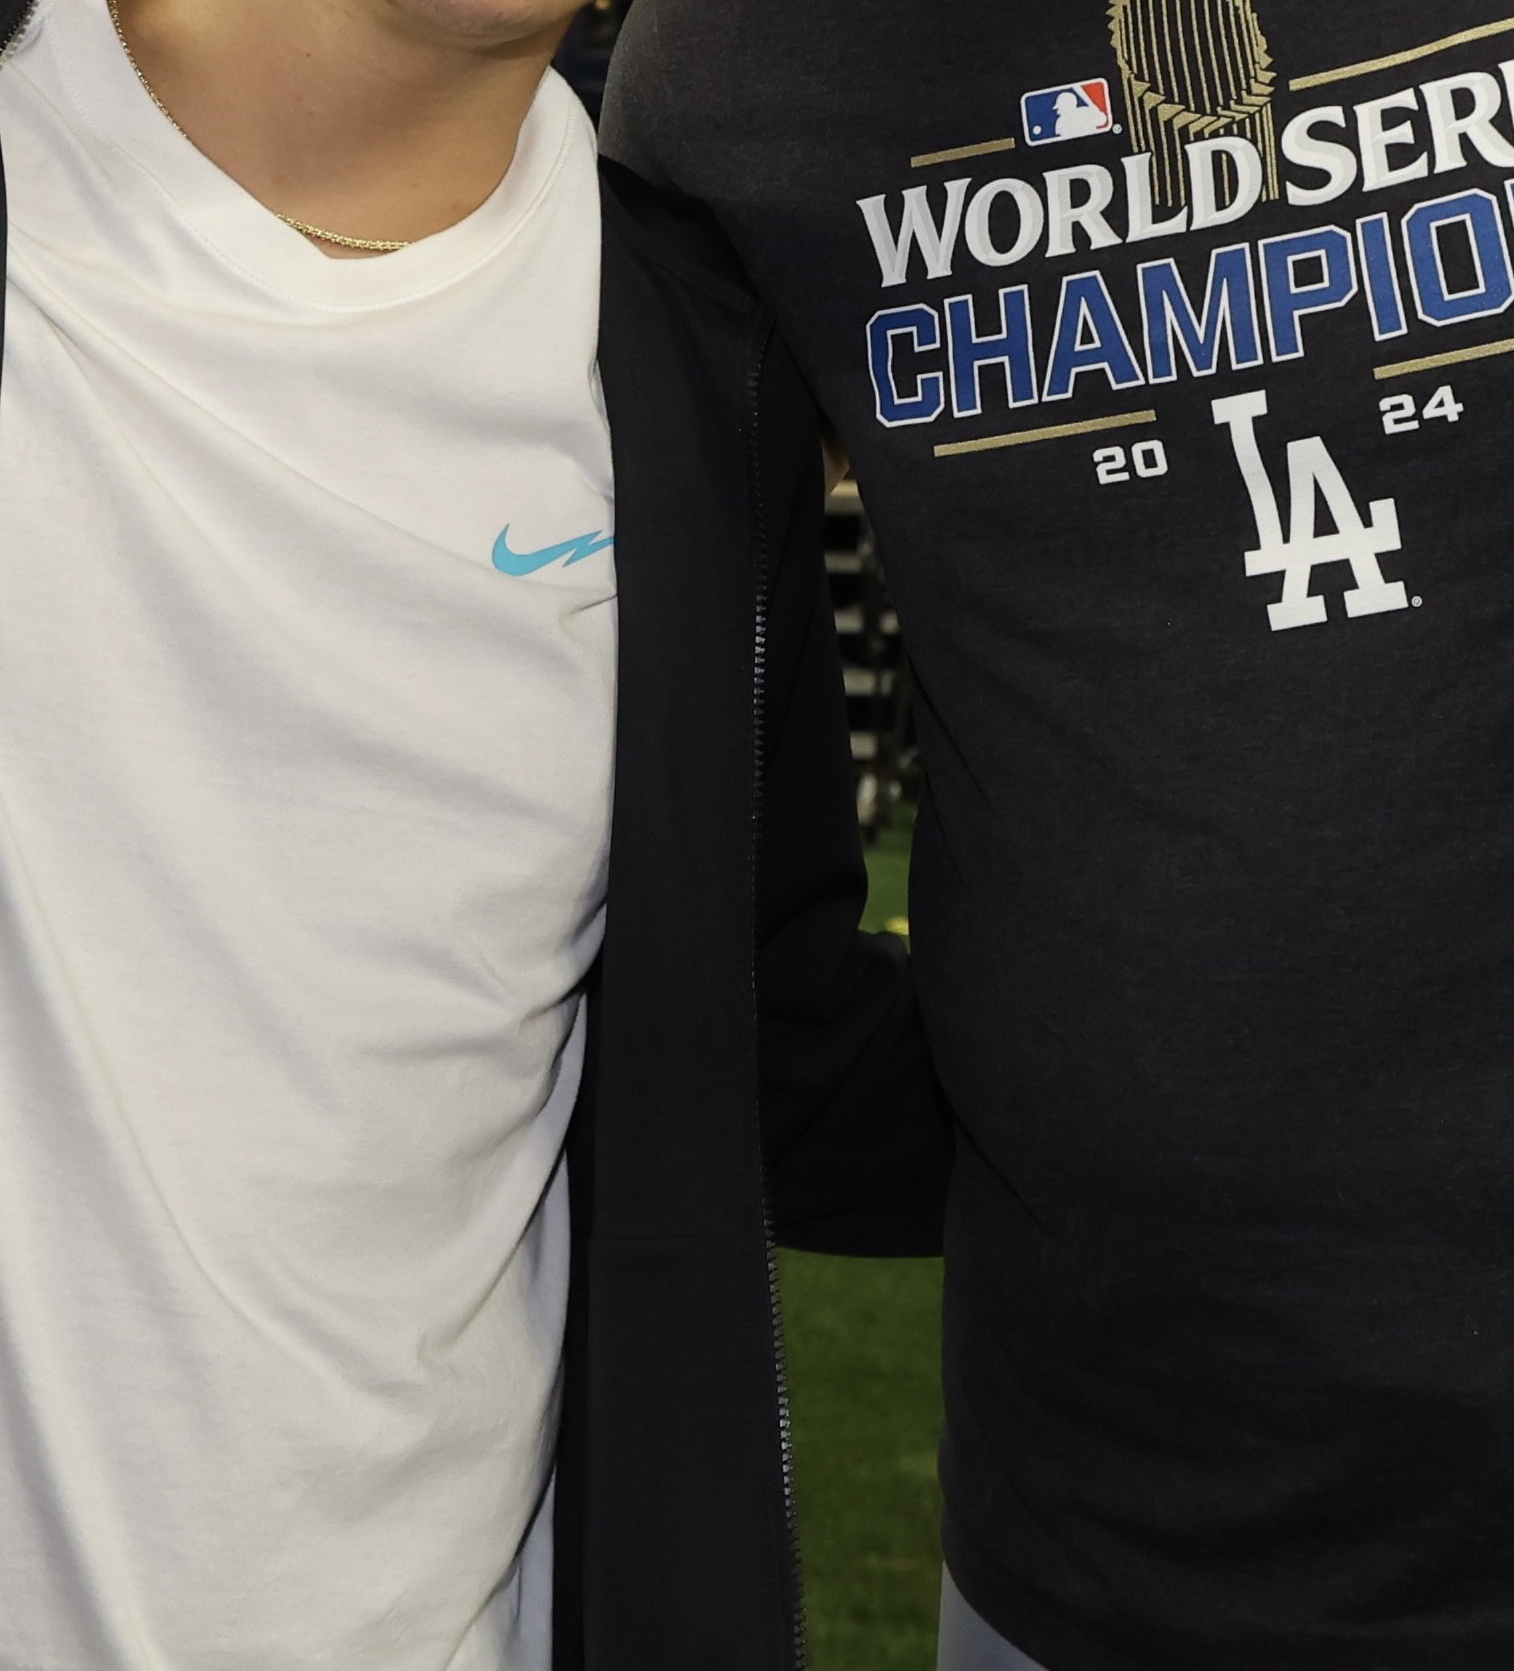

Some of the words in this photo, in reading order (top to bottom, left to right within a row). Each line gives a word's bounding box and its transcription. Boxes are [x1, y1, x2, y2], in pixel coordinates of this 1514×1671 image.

[855, 135, 1264, 288] WORLD
[1379, 385, 1464, 435] 24
[1093, 439, 1168, 485] 20
[1211, 389, 1409, 631] LA
